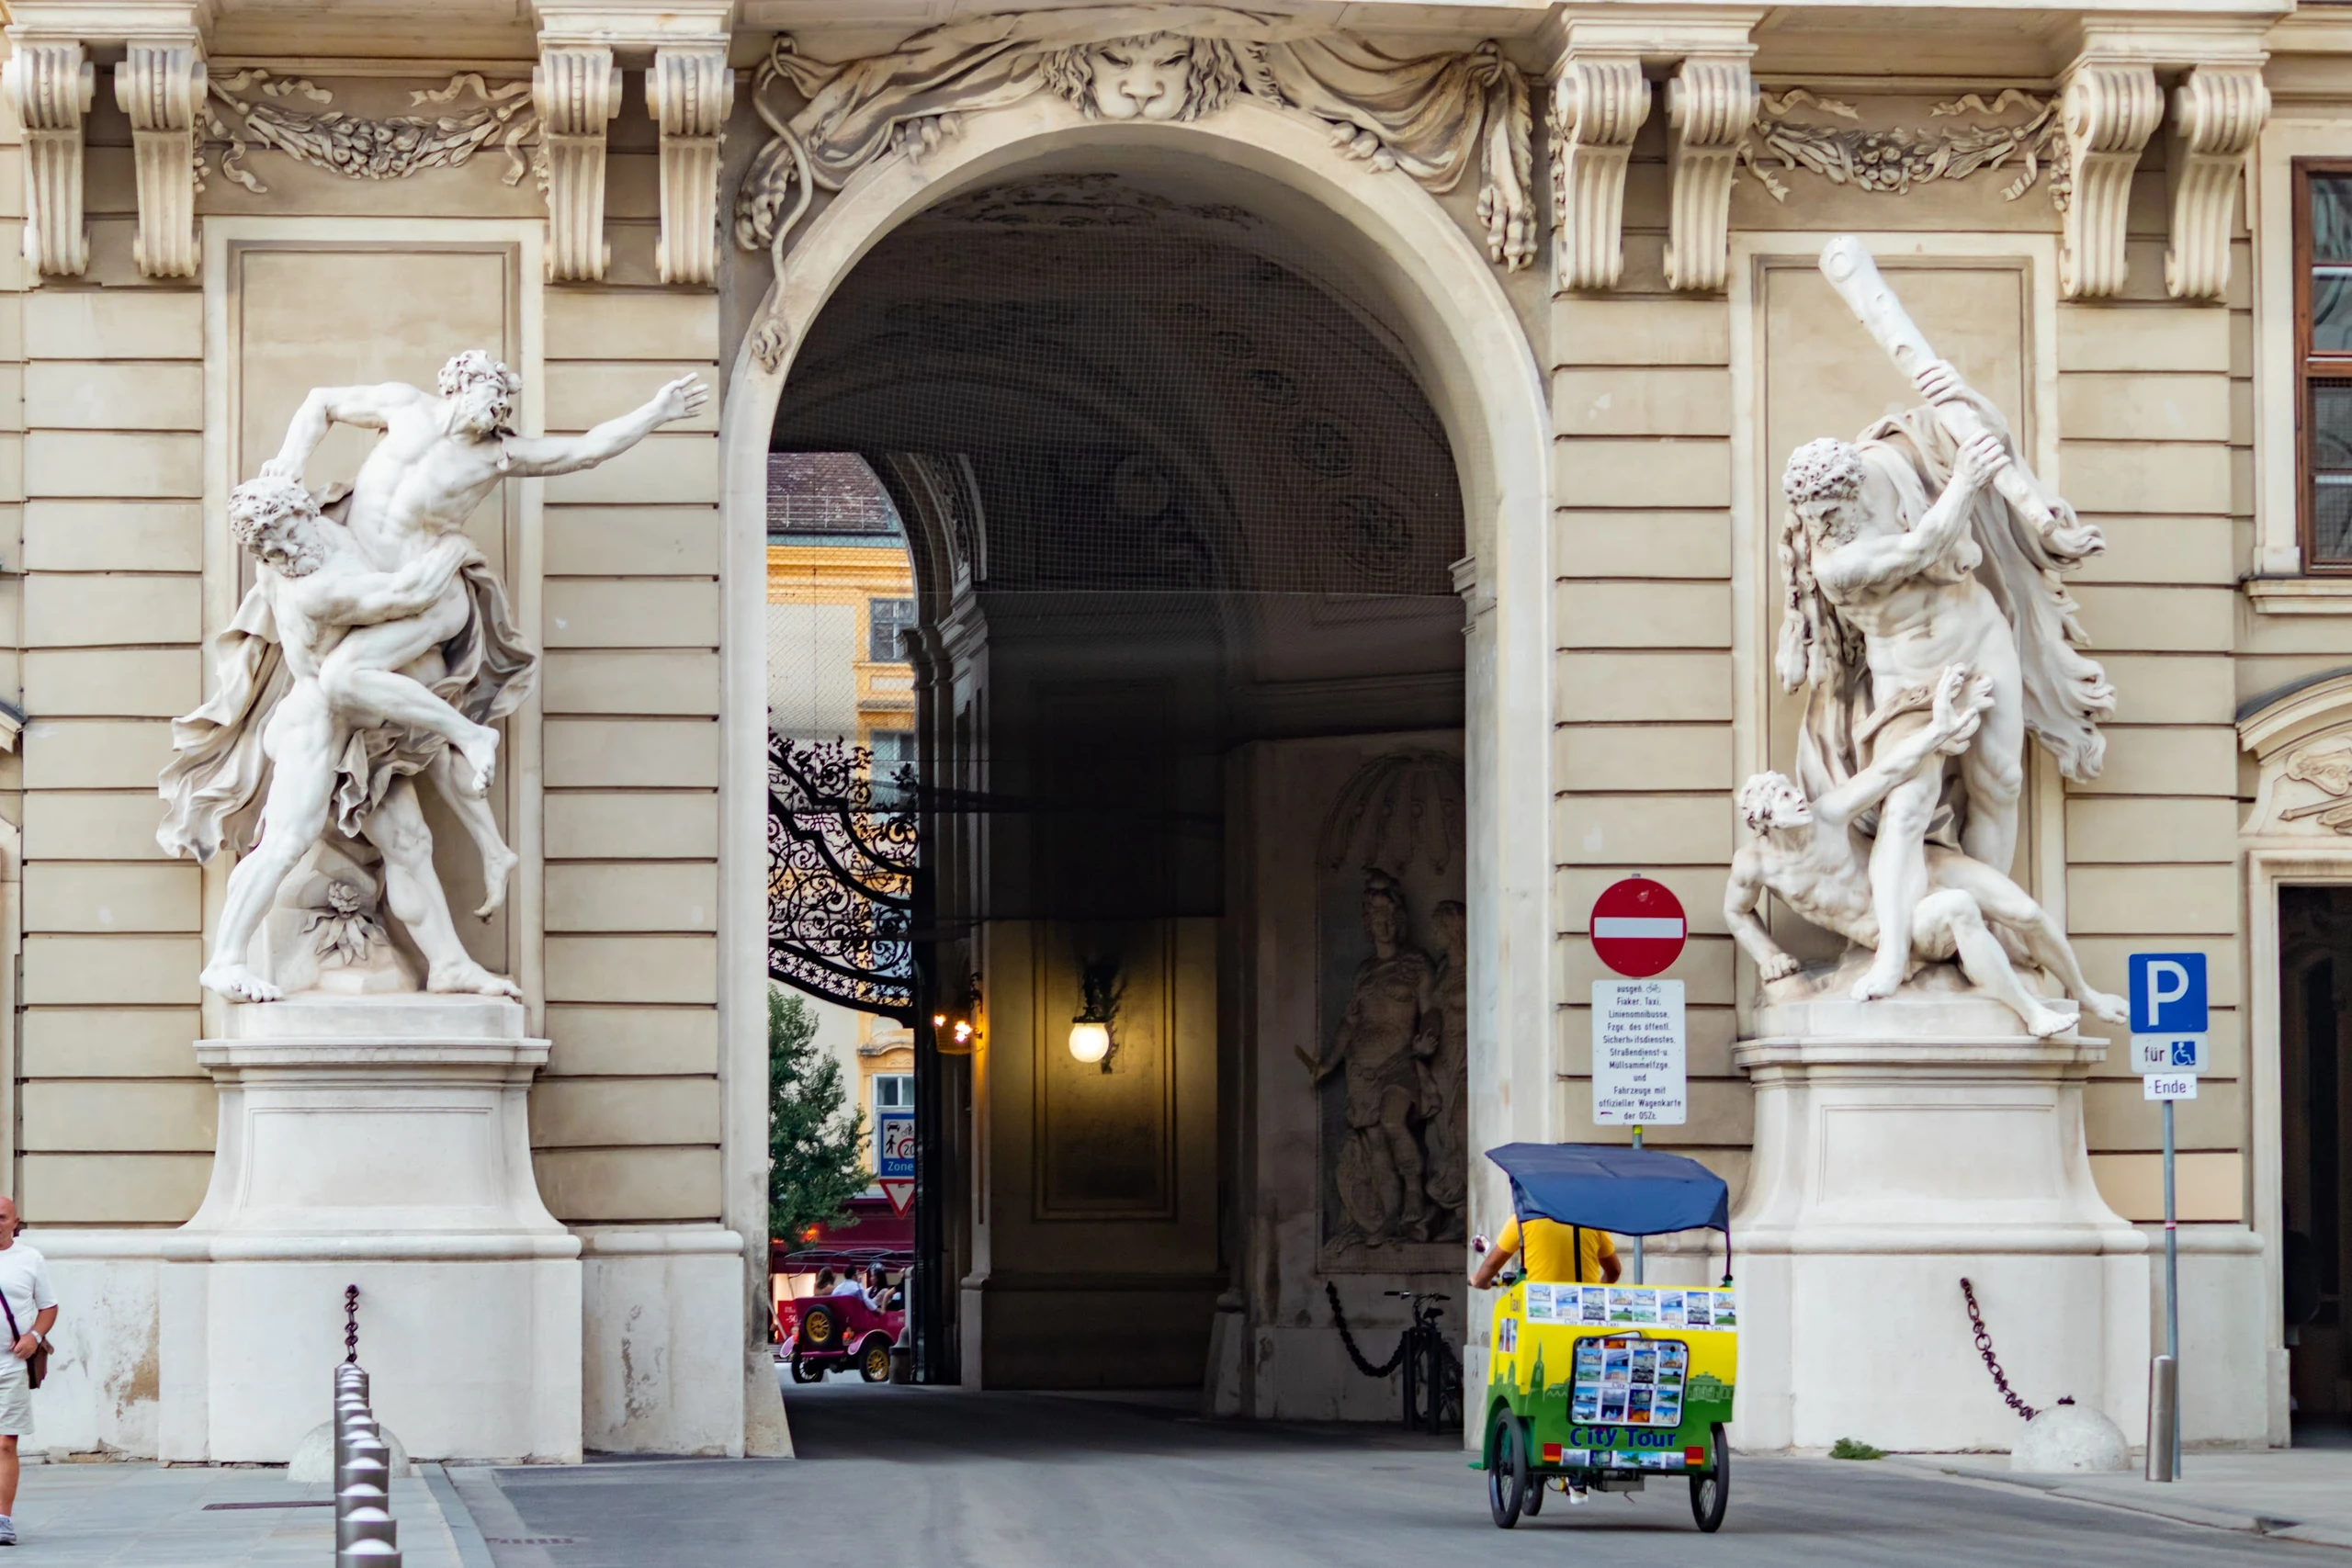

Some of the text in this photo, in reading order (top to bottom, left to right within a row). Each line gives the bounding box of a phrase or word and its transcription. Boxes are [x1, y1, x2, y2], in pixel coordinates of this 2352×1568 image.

[2147, 960, 2189, 1026] P
[1629, 1022, 1642, 1031] des
[2144, 1046, 2165, 1062] für
[1633, 1073, 1646, 1081] und
[1613, 1086, 1666, 1096] Fahrzeuge mit
[2154, 1078, 2186, 1094] Ende
[1599, 1099, 1681, 1110] offizieller Wagenkarte
[1623, 1111, 1635, 1120] der
[888, 1161, 914, 1172] Zone
[1569, 1427, 1676, 1448] City Tour
